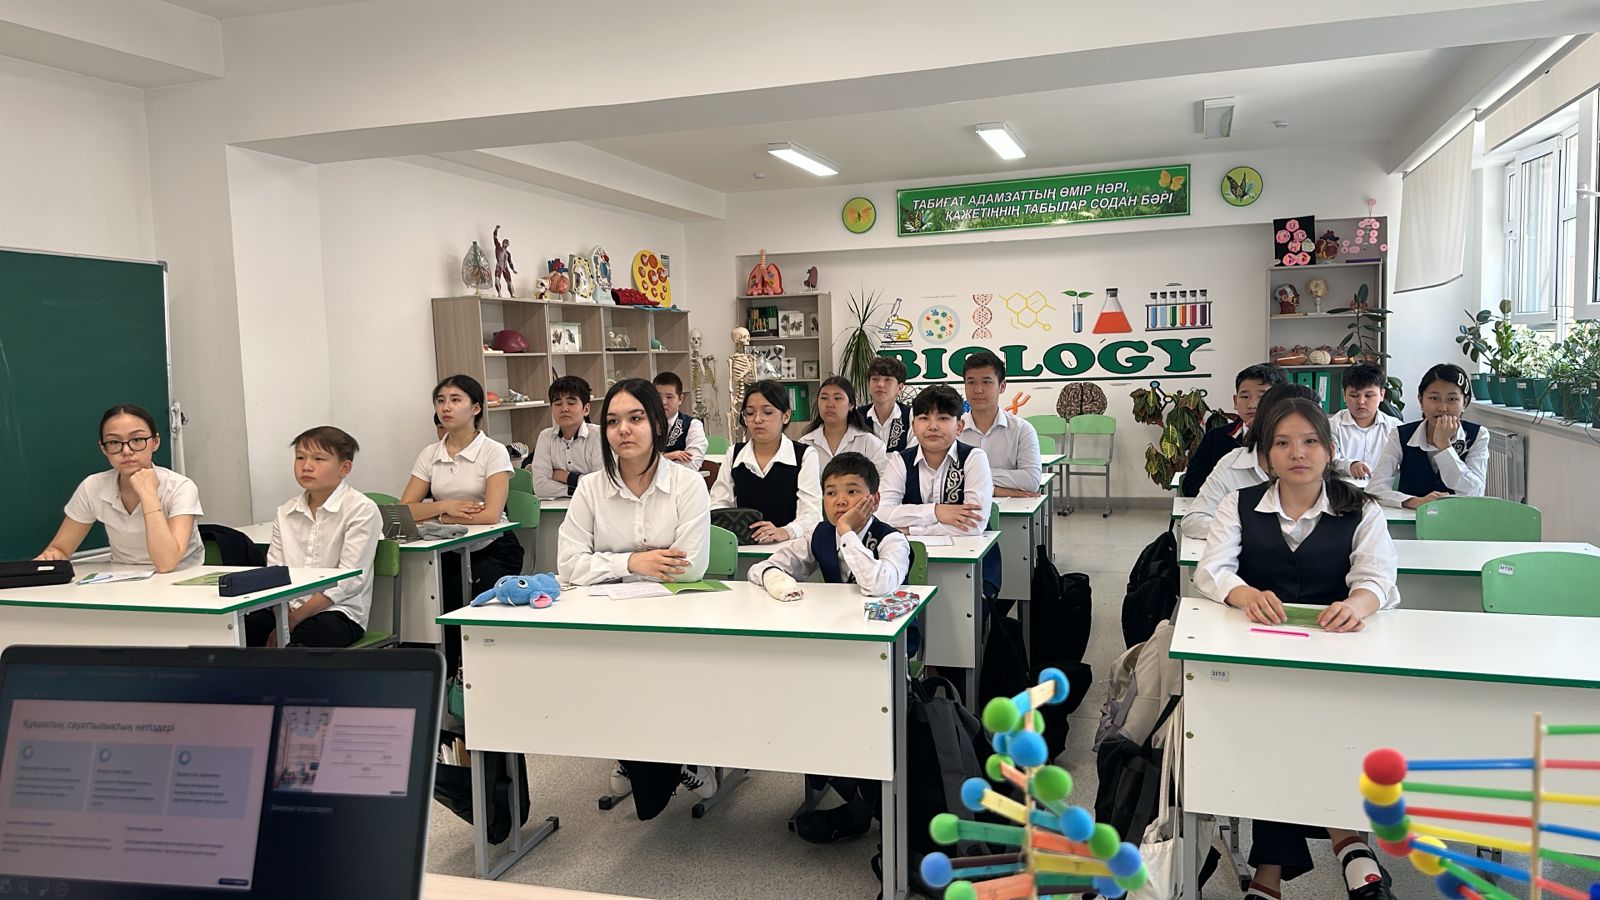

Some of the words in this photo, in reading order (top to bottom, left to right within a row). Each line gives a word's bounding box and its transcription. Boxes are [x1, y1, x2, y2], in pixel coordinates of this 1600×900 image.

[913, 196, 965, 210] ТАБИҒАТ
[968, 188, 1057, 206] АДАМЗАТТЫҢ
[1060, 185, 1092, 198] ӨМІР
[1095, 182, 1129, 195] НӘРІ,
[945, 205, 1020, 222] ҚАЖЕТІҢНІҢ
[1024, 200, 1087, 215] ТАБЫЛАР
[1090, 195, 1138, 210] СОДАН
[1141, 192, 1173, 206] БӘРІ
